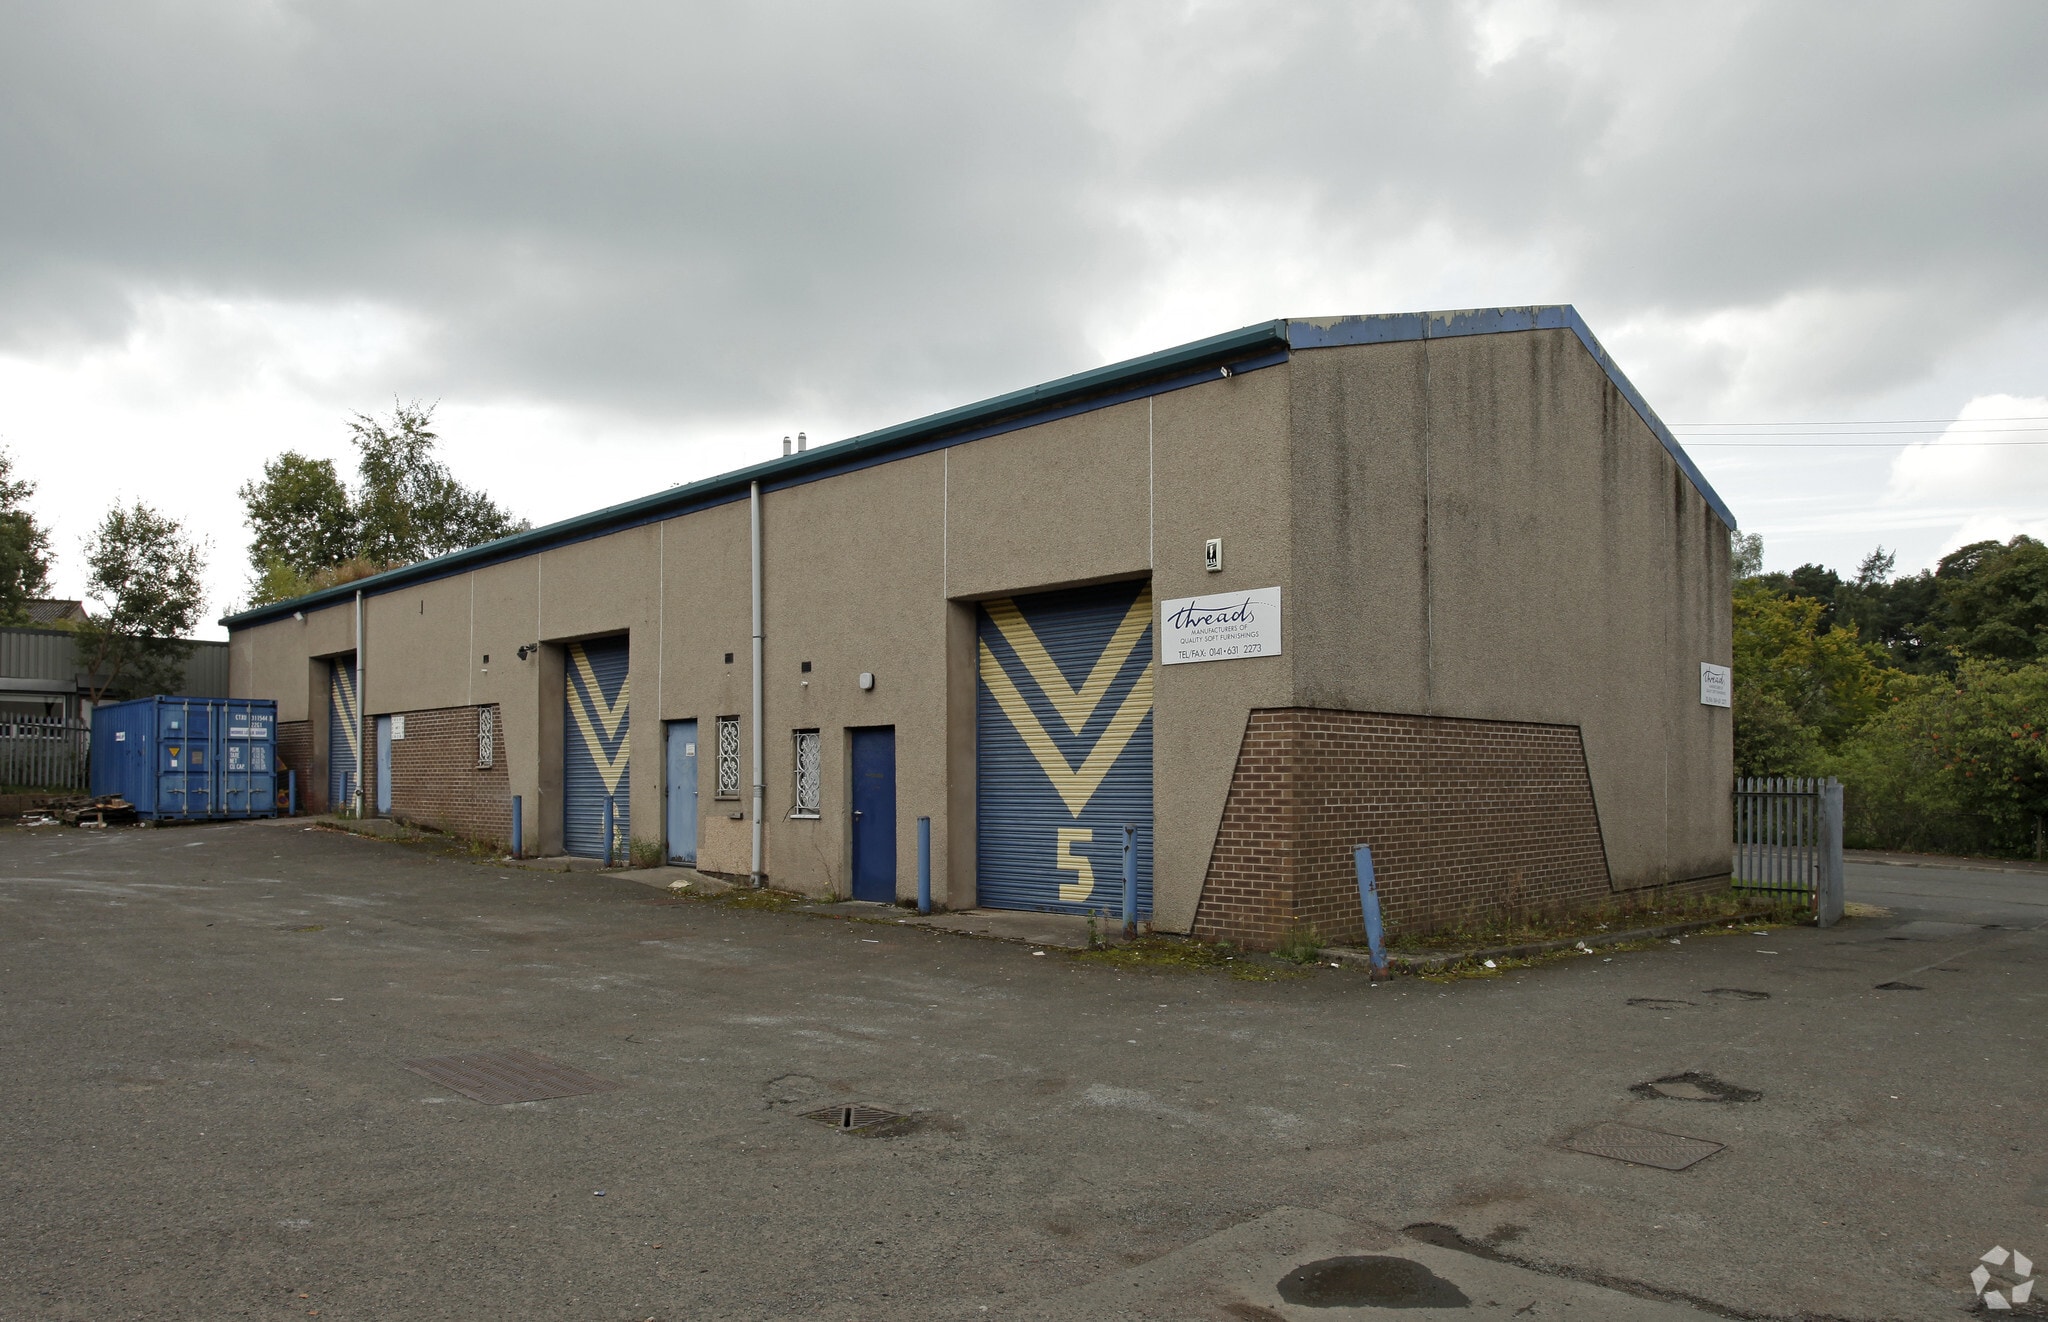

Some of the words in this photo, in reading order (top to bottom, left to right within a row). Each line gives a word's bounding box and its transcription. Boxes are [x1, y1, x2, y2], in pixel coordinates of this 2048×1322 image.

[1167, 597, 1255, 629] threads
[1191, 625, 1238, 635] MANUFACTURERS
[1180, 636, 1203, 645] QUALITY
[1205, 634, 1218, 643] SOFT
[1220, 631, 1260, 641] FURNISHINGS
[1244, 643, 1262, 654] 2273
[1057, 827, 1095, 902] 5
